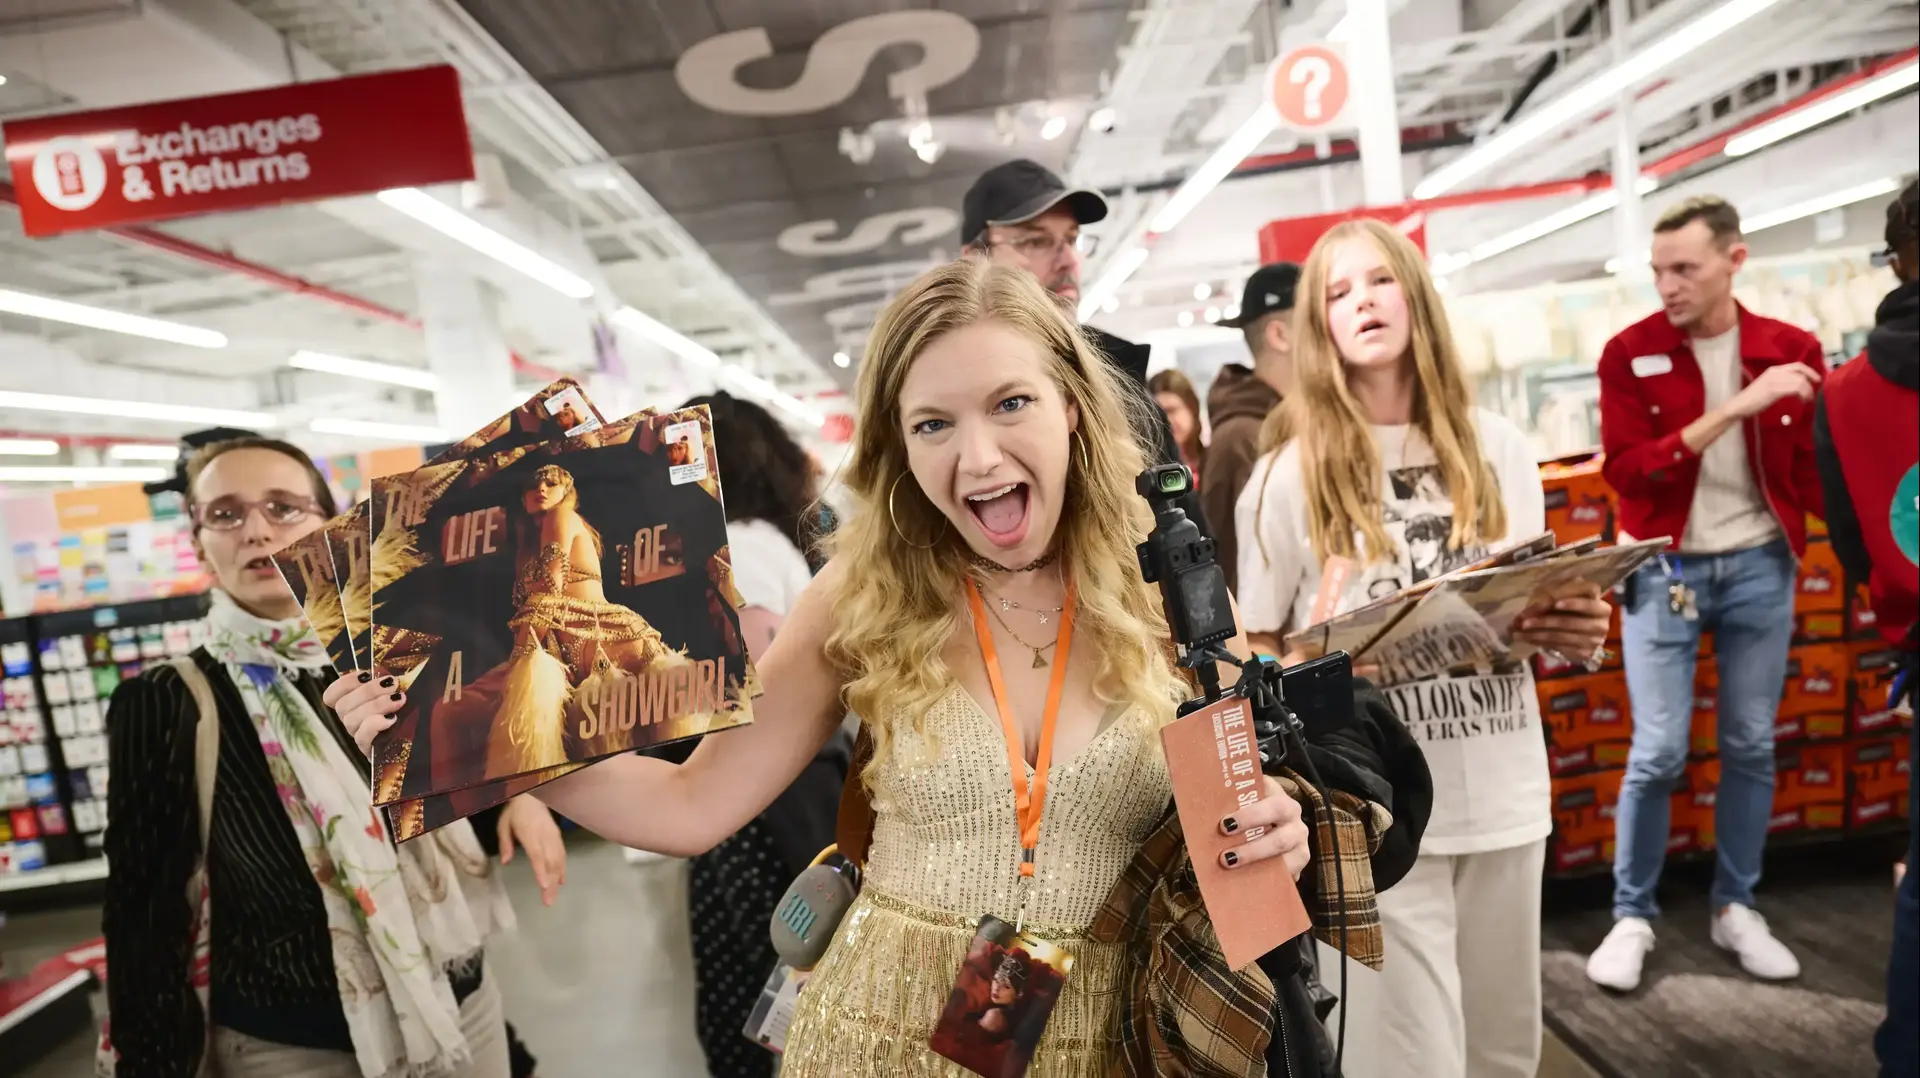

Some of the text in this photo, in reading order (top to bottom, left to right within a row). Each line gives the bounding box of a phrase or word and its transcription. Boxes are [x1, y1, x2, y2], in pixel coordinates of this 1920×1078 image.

[1289, 56, 1331, 119] ?
[115, 113, 321, 165] Exchanges
[122, 152, 310, 202] & Returns
[446, 506, 668, 577] LIFE OF
[442, 650, 732, 739] A SHOWGIRL
[1382, 682, 1466, 721] AYLOR
[1222, 704, 1246, 731] THE
[1426, 721, 1481, 741] ERAS
[1227, 731, 1250, 759] LIFE
[1232, 759, 1254, 776] OF
[1235, 779, 1256, 791] A
[779, 890, 818, 940] JBL
